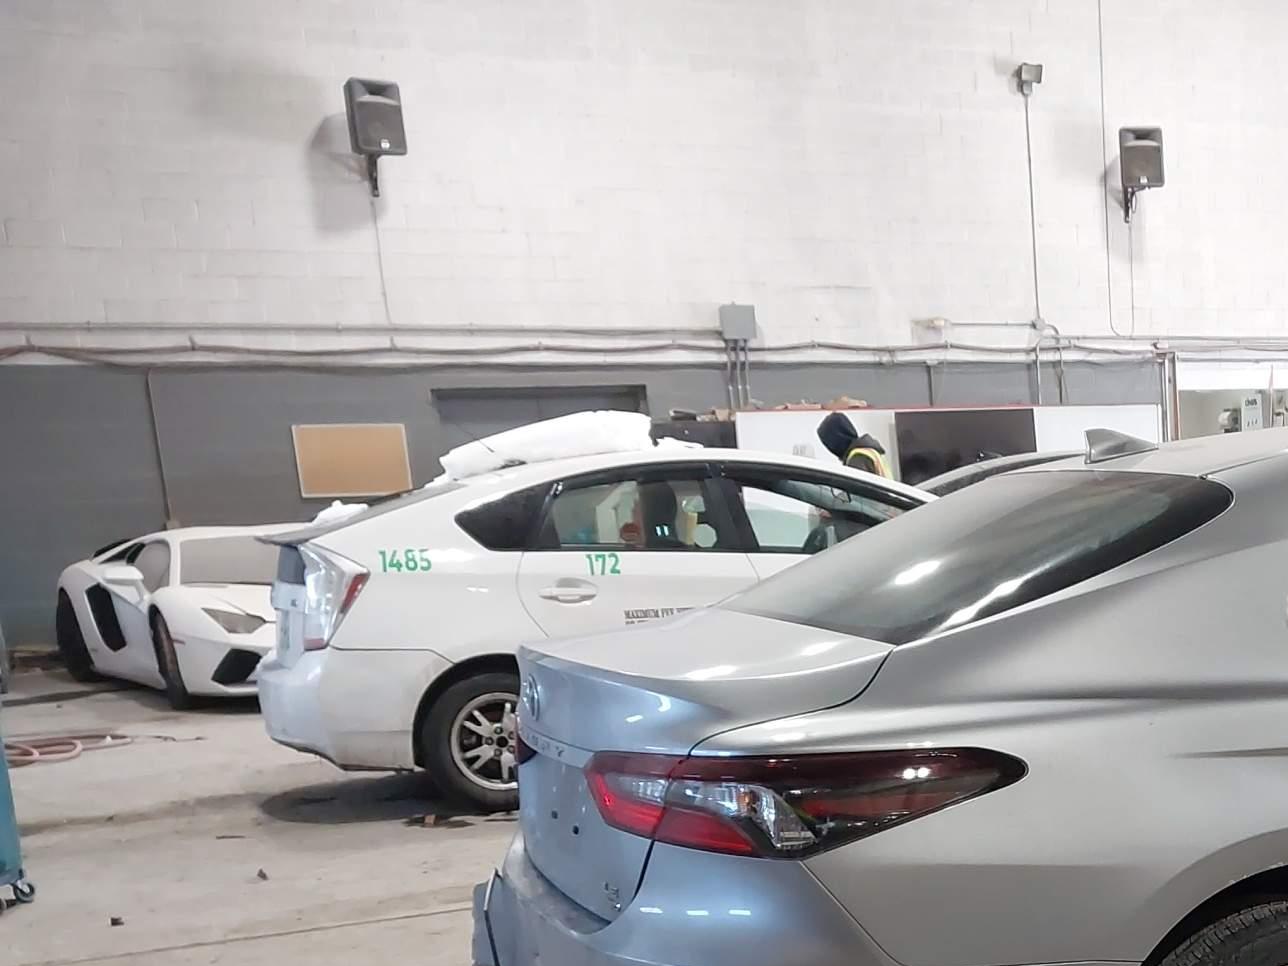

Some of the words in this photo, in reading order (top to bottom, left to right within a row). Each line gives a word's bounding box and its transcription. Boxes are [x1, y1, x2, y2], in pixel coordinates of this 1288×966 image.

[379, 548, 432, 573] 1485
[585, 552, 621, 576] 172
[624, 608, 660, 619] MAXIMUM
